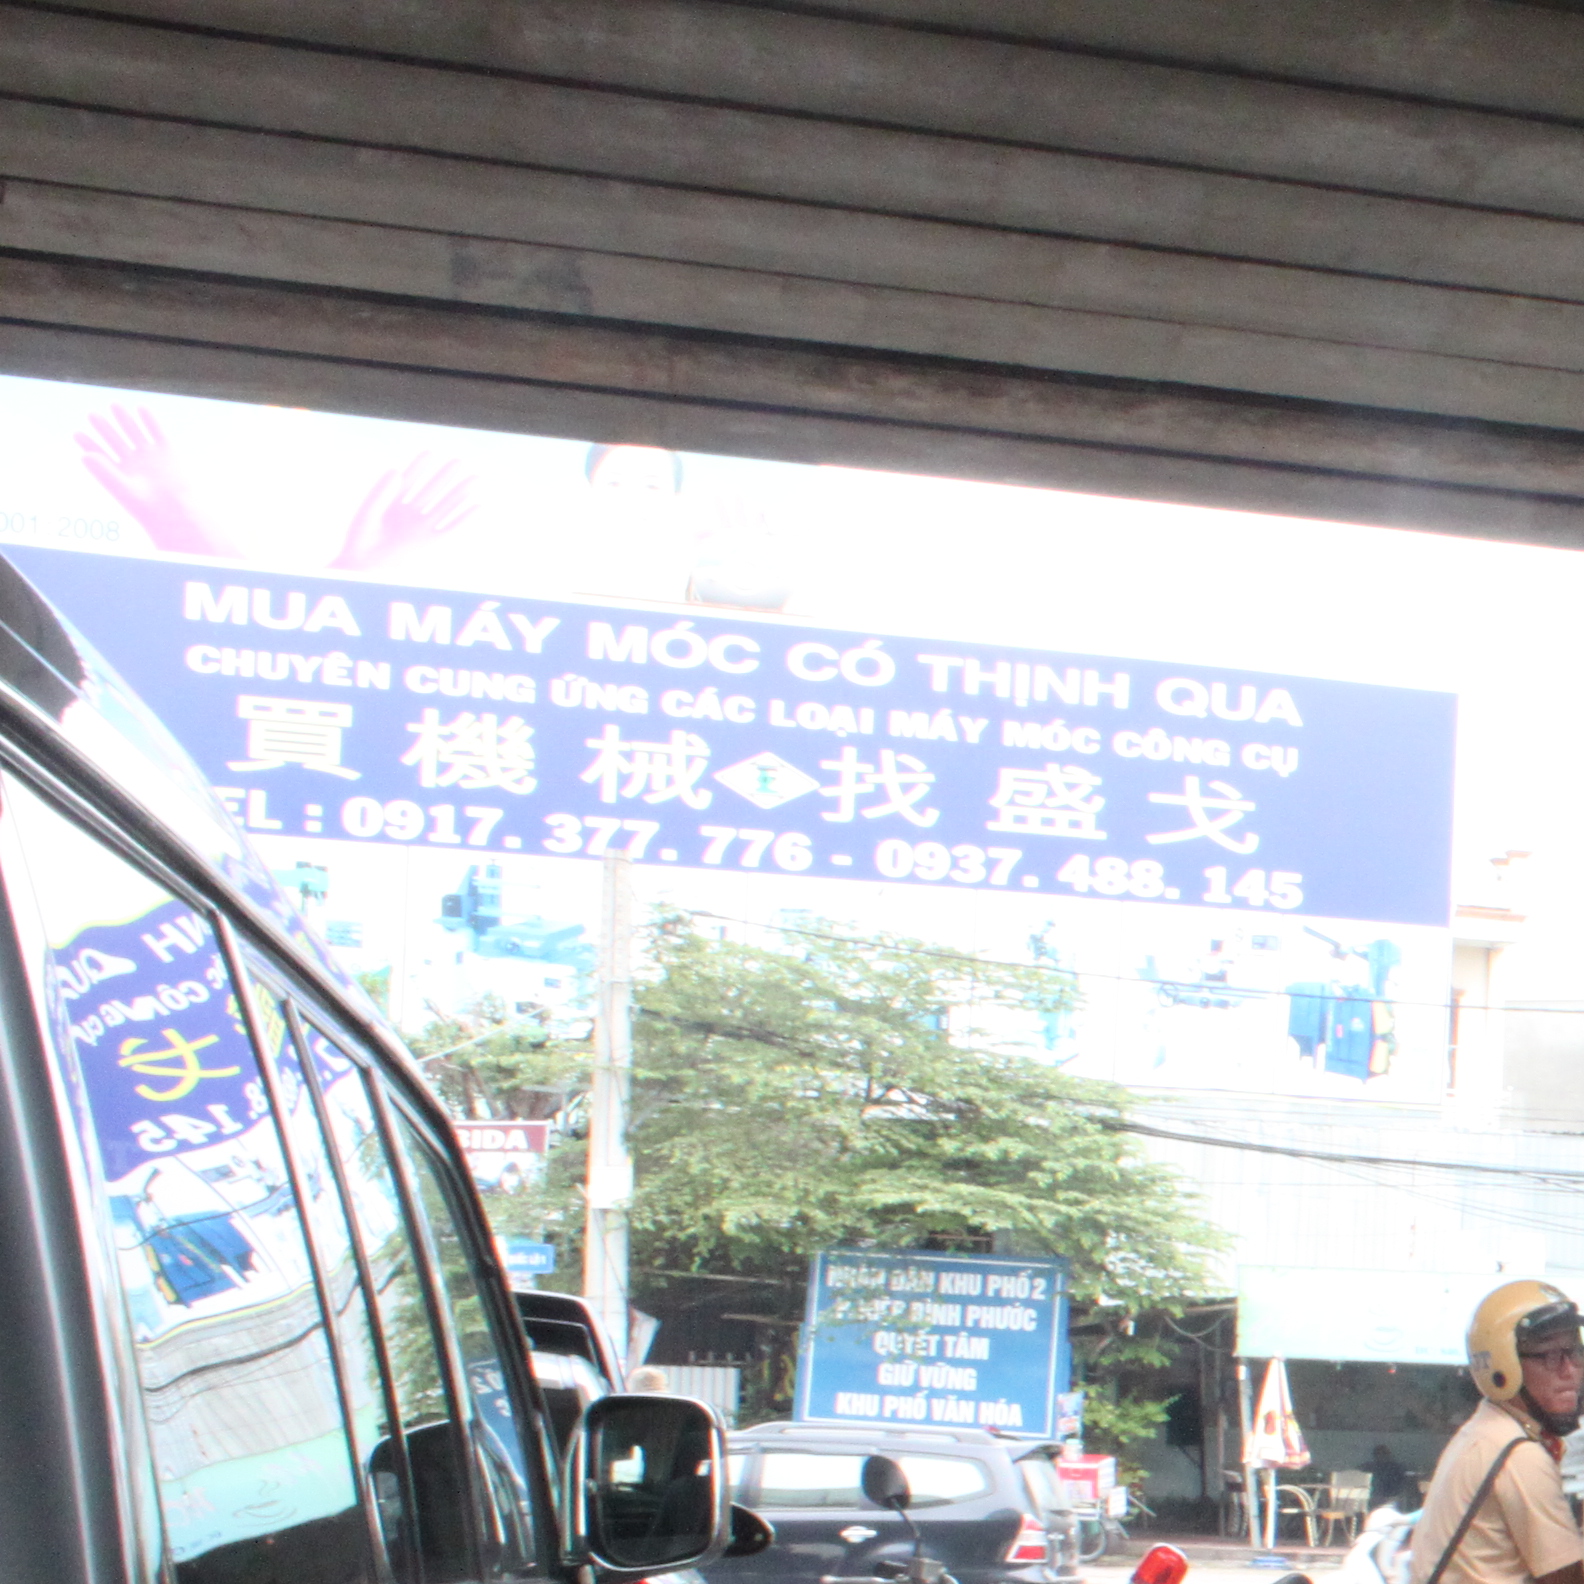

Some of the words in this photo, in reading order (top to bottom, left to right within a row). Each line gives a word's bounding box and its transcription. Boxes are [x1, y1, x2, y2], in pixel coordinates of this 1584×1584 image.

[184, 581, 361, 636] MUA
[388, 600, 560, 653] MÁY
[587, 620, 761, 674] MÓC
[787, 639, 896, 687] CÓ
[917, 653, 1131, 708] THỊNH
[1156, 676, 1304, 727] QUA
[184, 643, 391, 690] CHUYÊN
[404, 665, 537, 704] CUNG
[549, 672, 649, 715] ỨNG
[660, 686, 756, 724] CÁC
[769, 698, 875, 738] LOẠI
[889, 709, 989, 744] MÁY
[1002, 719, 1101, 755] MÓC
[1112, 727, 1231, 767] CÔNG
[1241, 742, 1299, 778] CỤ
[211, 785, 282, 830] EL
[699, 825, 813, 872] 776
[1203, 865, 1303, 909] 145
[939, 1271, 982, 1296] KHU
[986, 1269, 1032, 1299] PHỐ
[1031, 1277, 1047, 1300] 2
[965, 1302, 1038, 1331] PHƯỚC
[943, 1331, 991, 1360] TÂM
[877, 1359, 918, 1387] GIỮ
[918, 1362, 978, 1391] VỮNG
[834, 1391, 880, 1417] KHU
[882, 1389, 929, 1420] PHỐ
[930, 1394, 975, 1425] VĂN
[977, 1398, 1023, 1427] HÓA
